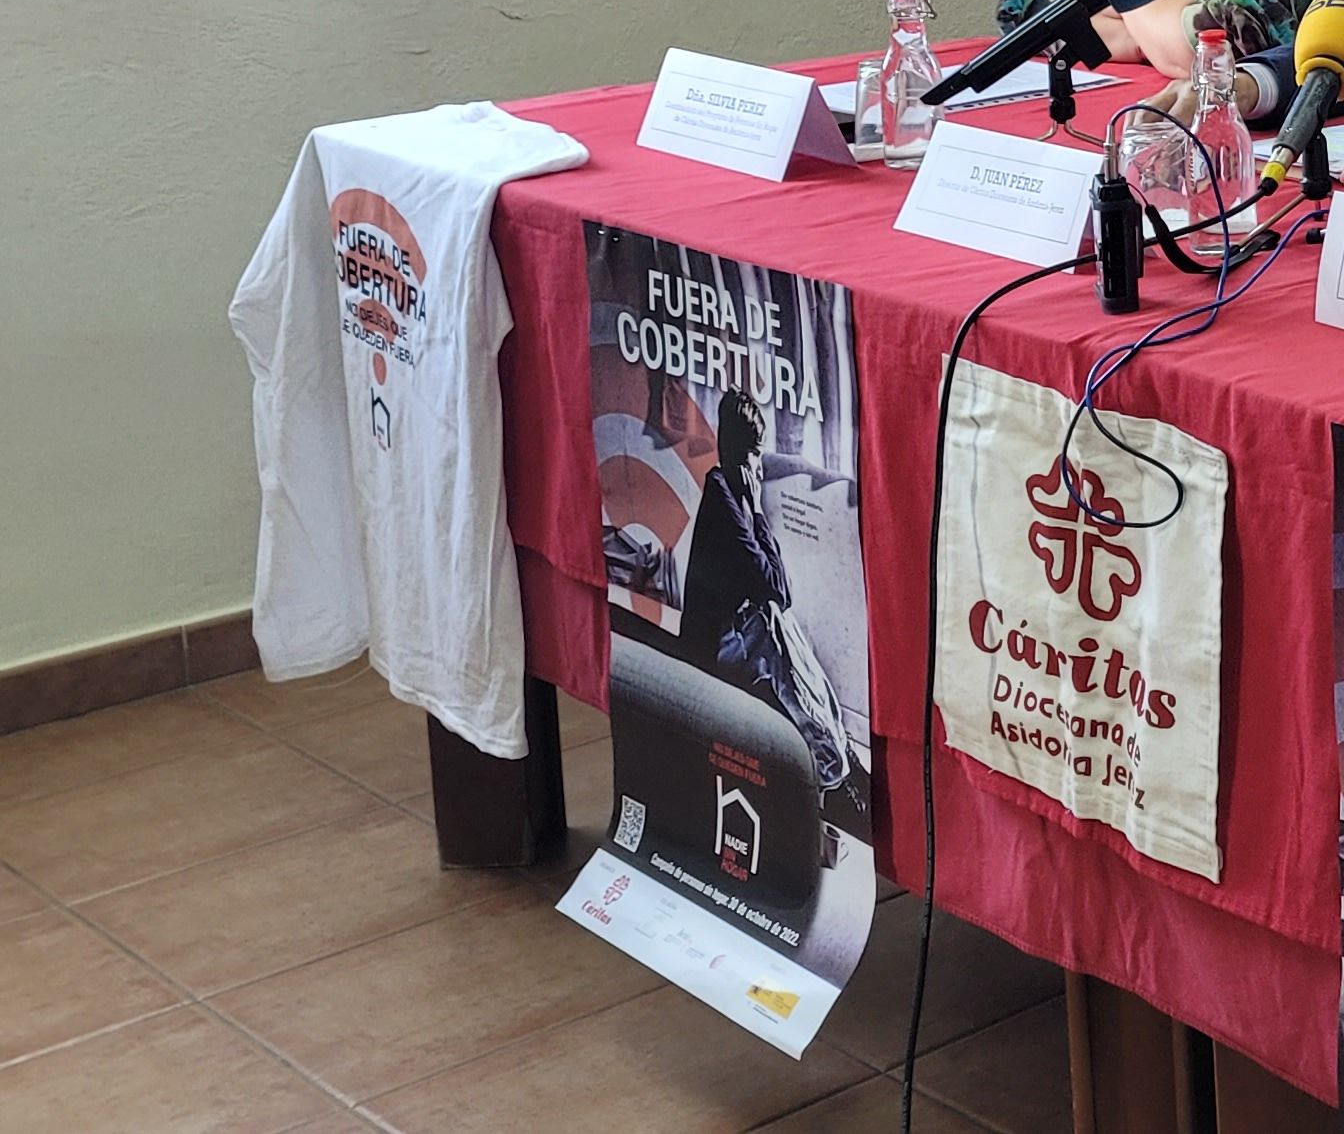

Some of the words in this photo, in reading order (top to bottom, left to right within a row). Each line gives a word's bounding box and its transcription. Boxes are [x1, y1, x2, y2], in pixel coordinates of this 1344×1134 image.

[981, 169, 1010, 187] JUAN
[1010, 172, 1044, 194] PÉREZ
[338, 220, 387, 267] FUERA
[392, 244, 411, 277] DE
[335, 251, 427, 326] OBERTURA
[648, 269, 739, 334] FUERA
[745, 295, 782, 347] DE
[617, 312, 824, 422] COBERTURA
[969, 599, 1177, 729] Cáritas
[1102, 753, 1146, 810] Jerz
[724, 833, 748, 856] NADIE
